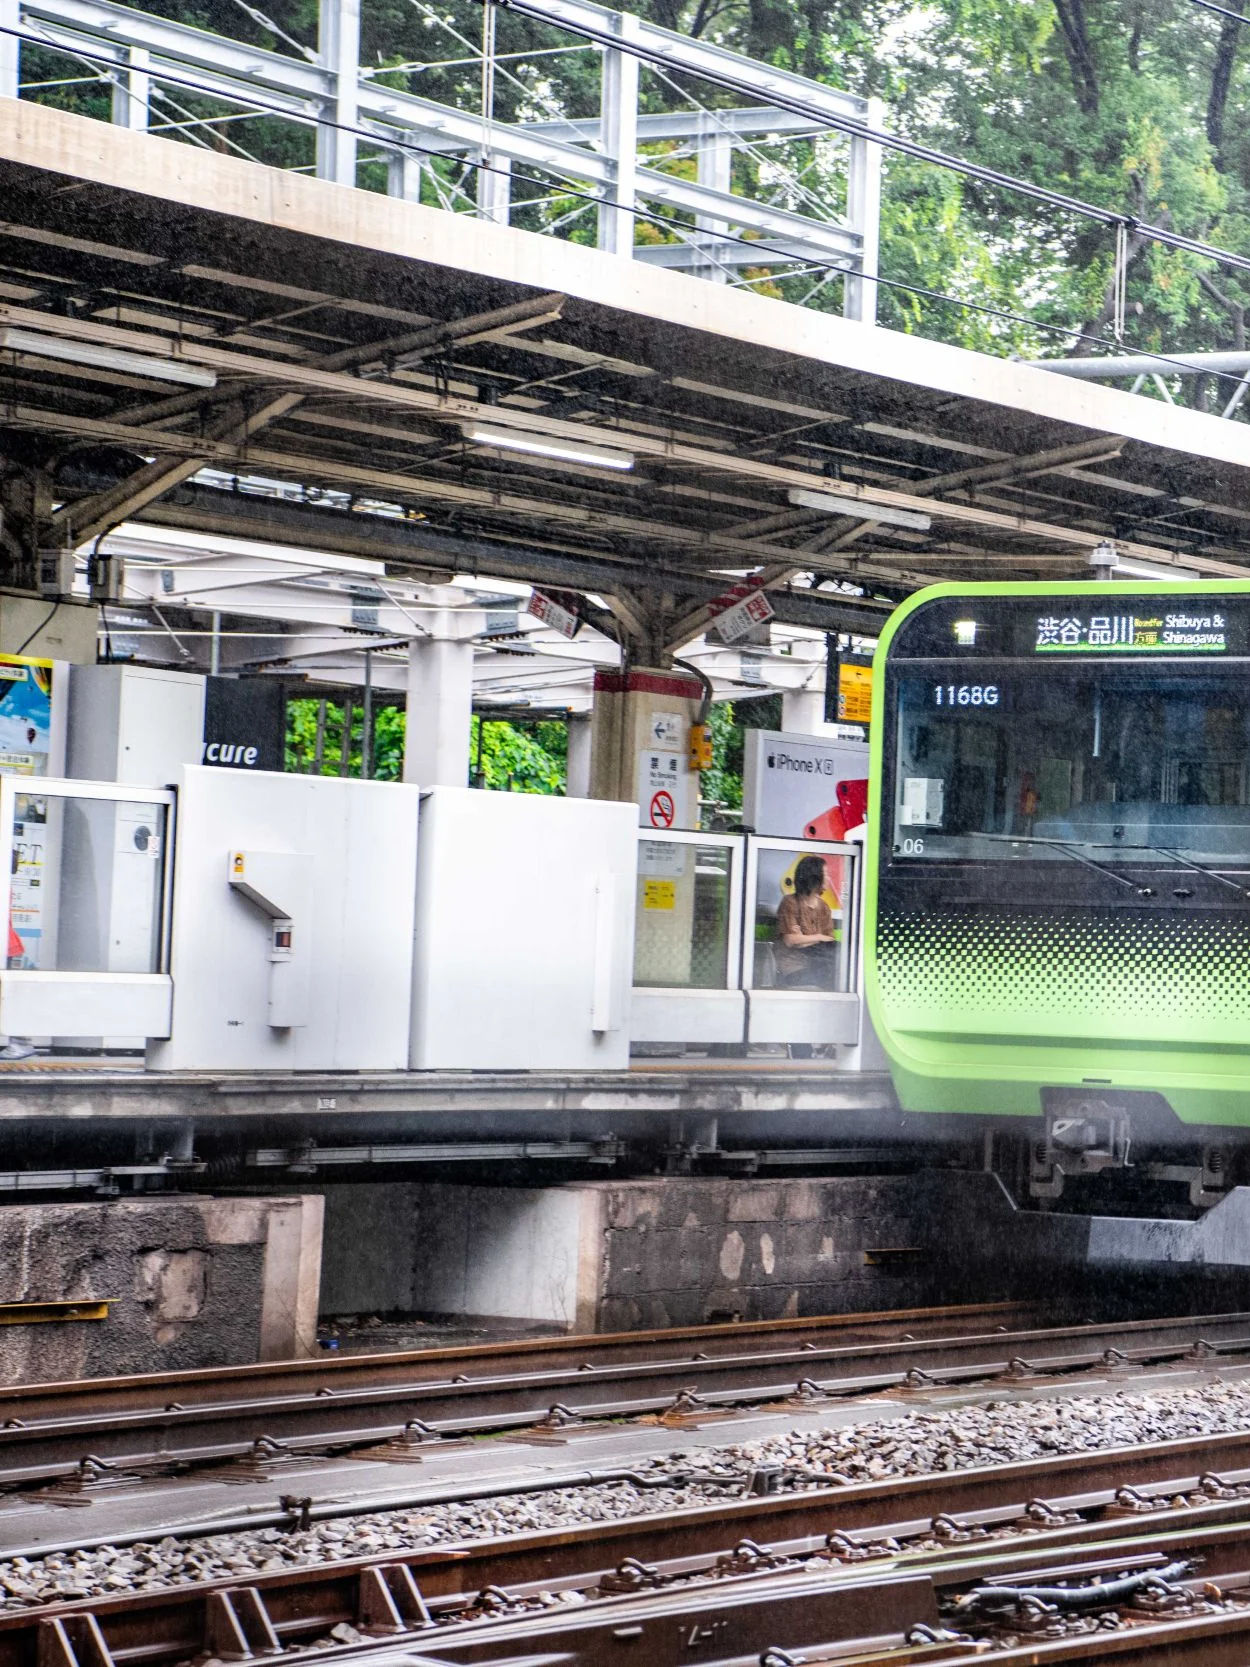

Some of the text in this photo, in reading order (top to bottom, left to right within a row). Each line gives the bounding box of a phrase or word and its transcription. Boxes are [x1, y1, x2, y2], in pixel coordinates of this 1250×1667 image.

[1165, 614, 1225, 631] Shibuya &
[1162, 631, 1225, 647] Shinagawa
[934, 685, 999, 705] 1168G
[202, 742, 258, 765] cure
[777, 753, 813, 773] iPhone
[903, 838, 924, 854] 06
